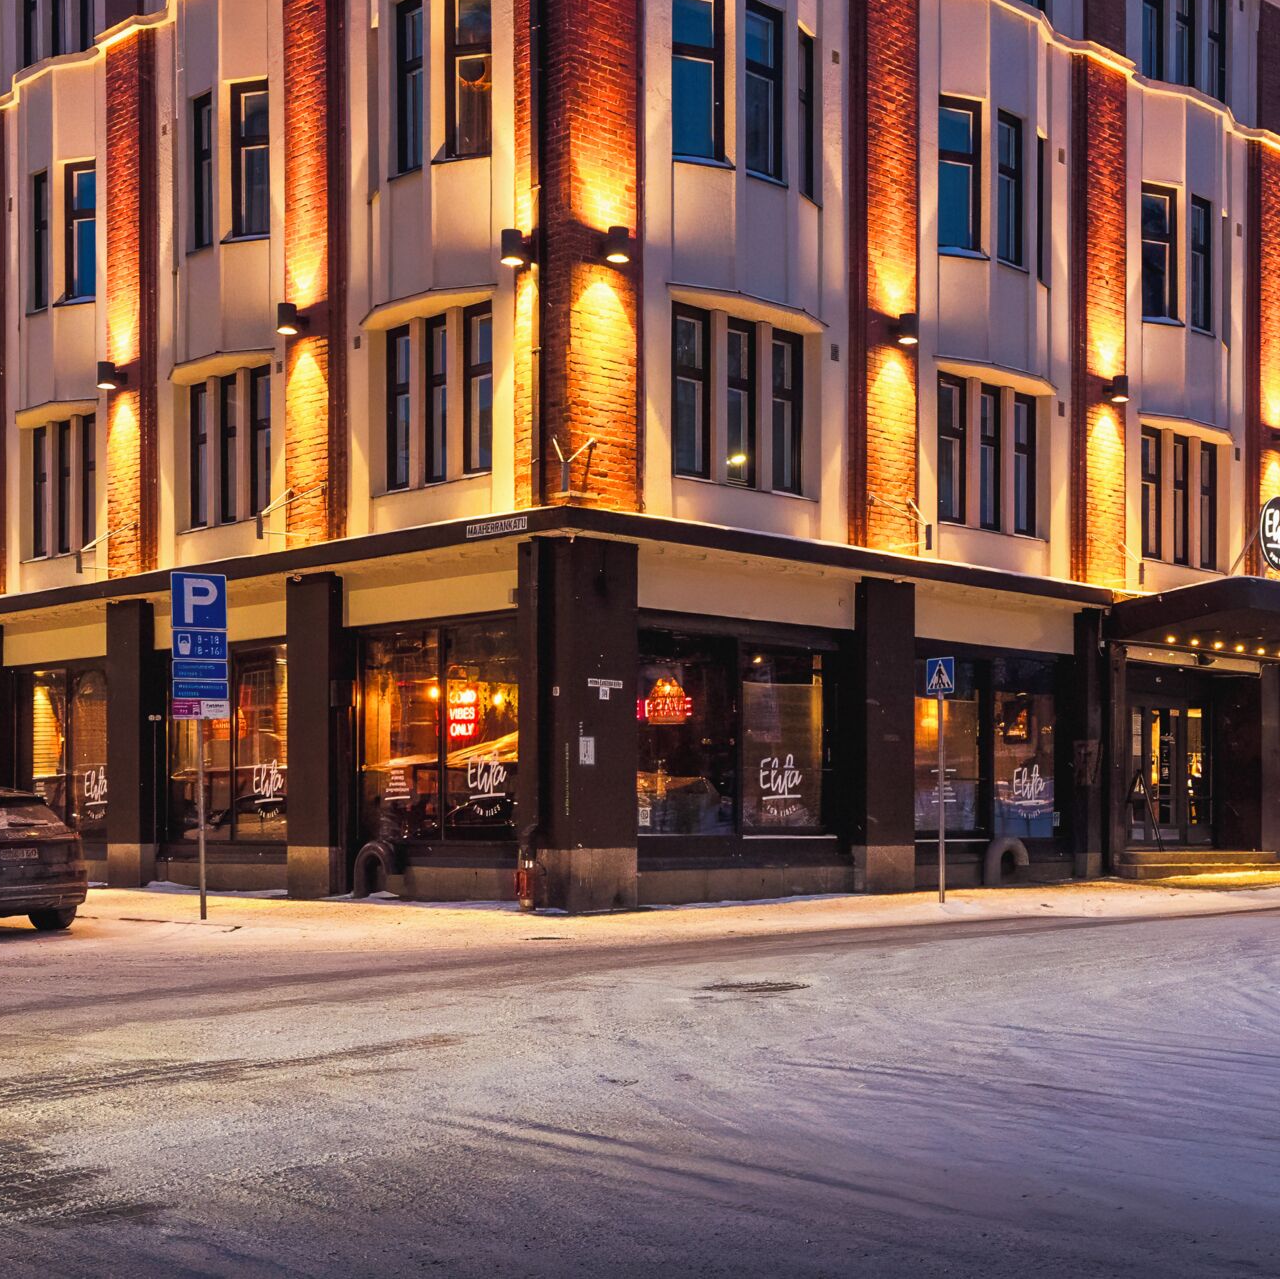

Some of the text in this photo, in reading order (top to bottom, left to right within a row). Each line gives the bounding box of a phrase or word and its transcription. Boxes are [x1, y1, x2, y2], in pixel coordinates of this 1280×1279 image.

[184, 578, 218, 623] P
[450, 707, 475, 719] VIBES
[450, 723, 475, 736] ONLY
